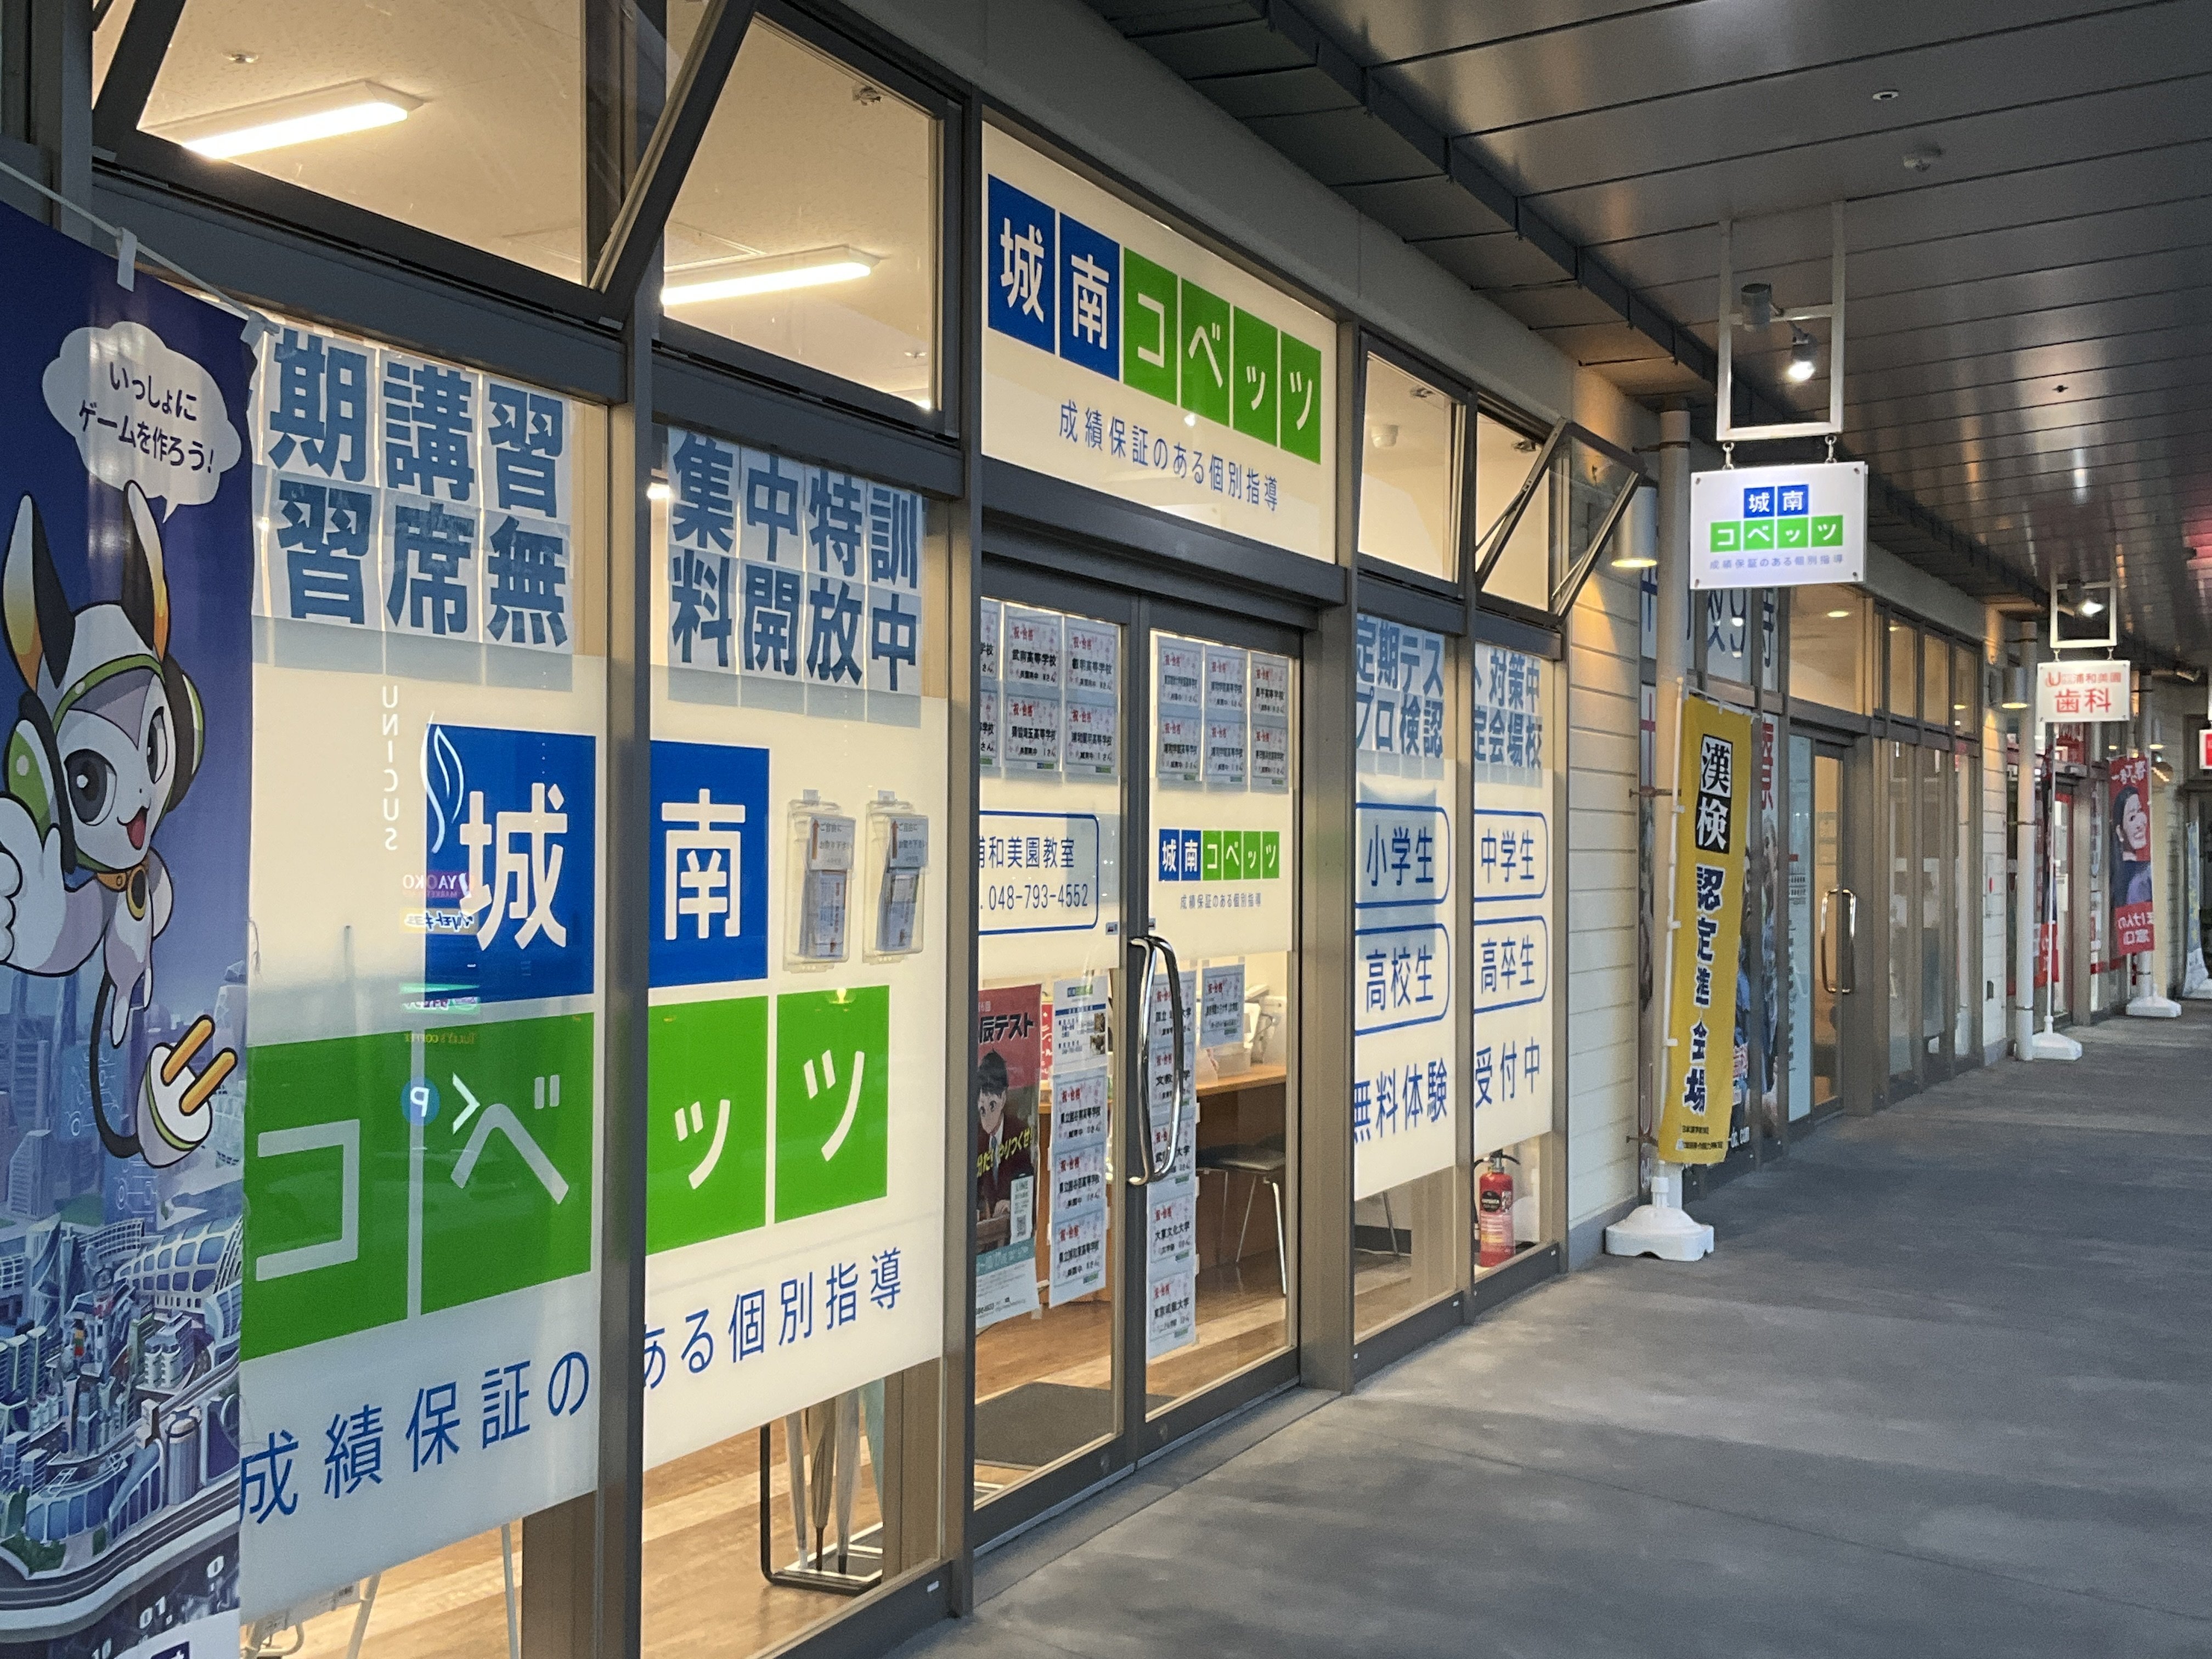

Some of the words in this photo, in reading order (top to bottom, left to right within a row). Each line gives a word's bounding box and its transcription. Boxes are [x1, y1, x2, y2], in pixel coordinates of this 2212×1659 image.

[1000, 217, 1312, 431] 城南コベッツ
[110, 362, 197, 421] いっしょに
[78, 399, 215, 473] ゲームを作ろう!
[1059, 399, 1279, 512] 成績保証のある個別指導
[1748, 490, 1804, 513] 城南
[1710, 554, 1844, 569] 成績保証のある個別指導
[1718, 524, 1837, 546] コベッツ
[2055, 688, 2112, 713] 歯科
[1162, 838, 1277, 872] 城南コベッツ
[1367, 825, 1434, 887] 小学生
[1481, 827, 1534, 883] 中学生
[989, 883, 1088, 911] 048-793-4552
[1366, 944, 1434, 1013] 高校生
[1481, 935, 1534, 994] 高卒生
[1354, 1057, 1448, 1144] 無料体験
[1475, 1036, 1541, 1109] 受付中
